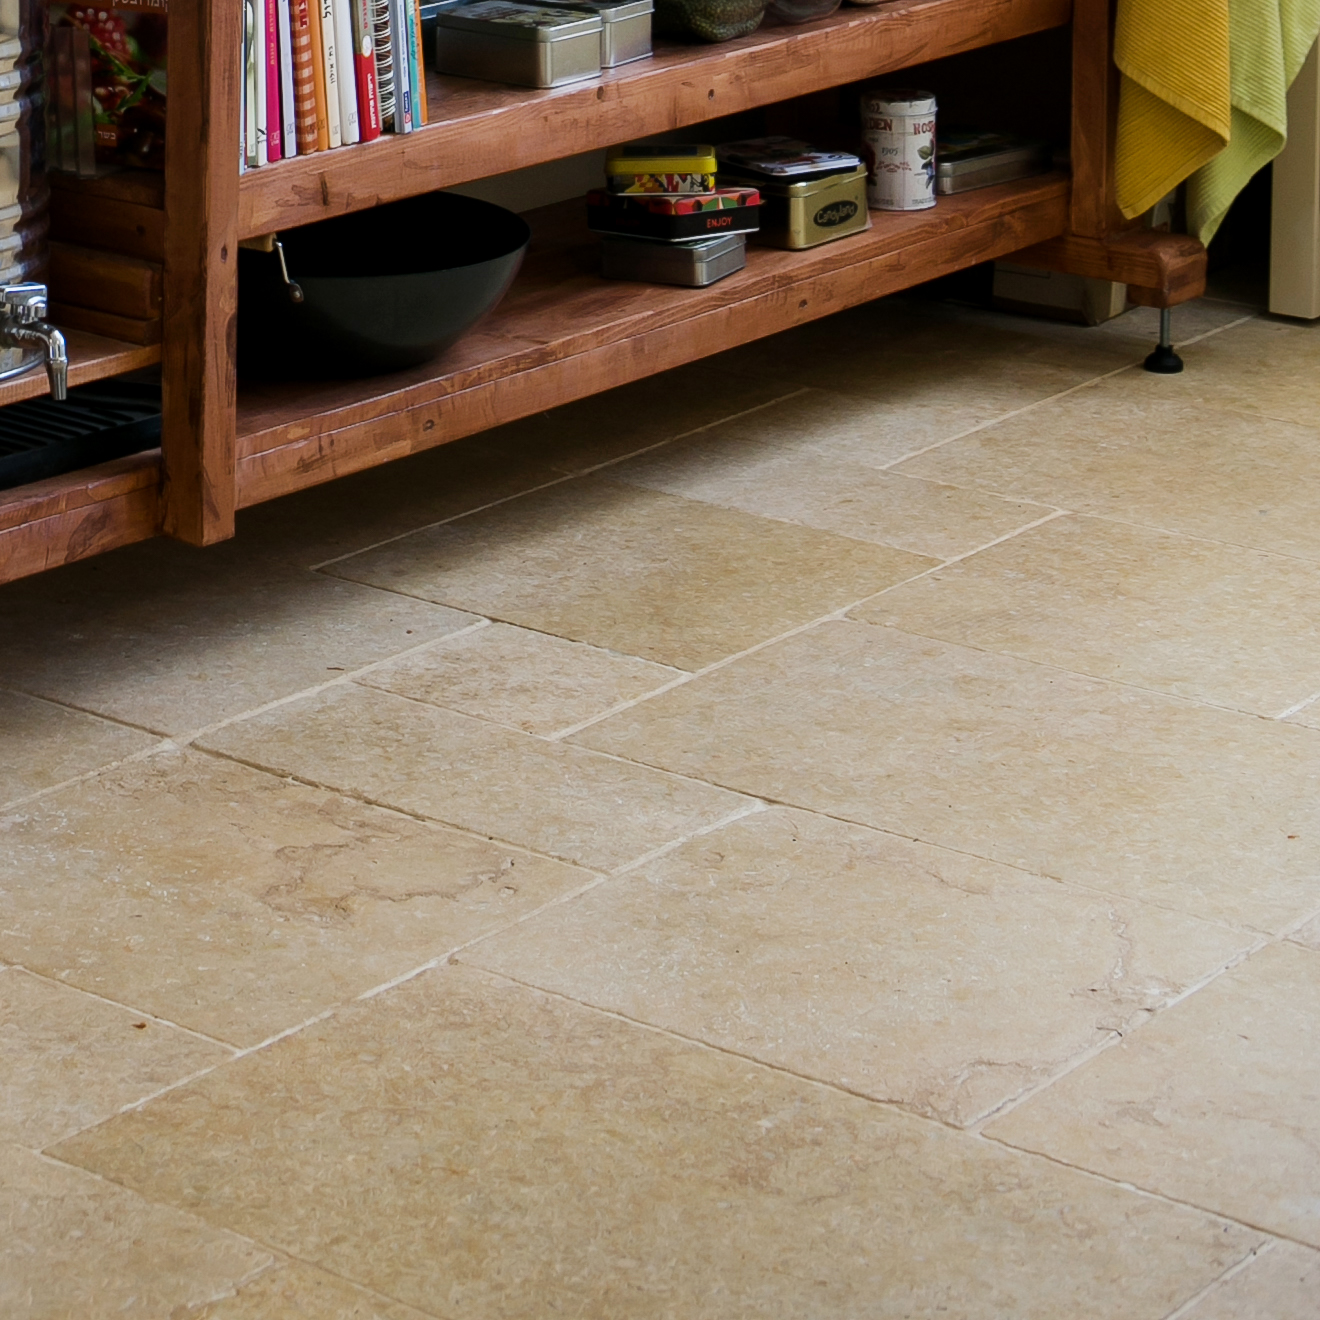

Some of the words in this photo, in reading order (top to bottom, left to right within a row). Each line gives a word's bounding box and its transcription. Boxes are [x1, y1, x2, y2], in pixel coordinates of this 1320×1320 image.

[97, 130, 118, 141] כשר
[881, 146, 899, 157] 1905
[816, 203, 856, 225] Candyland
[706, 216, 733, 229] ENJOY
